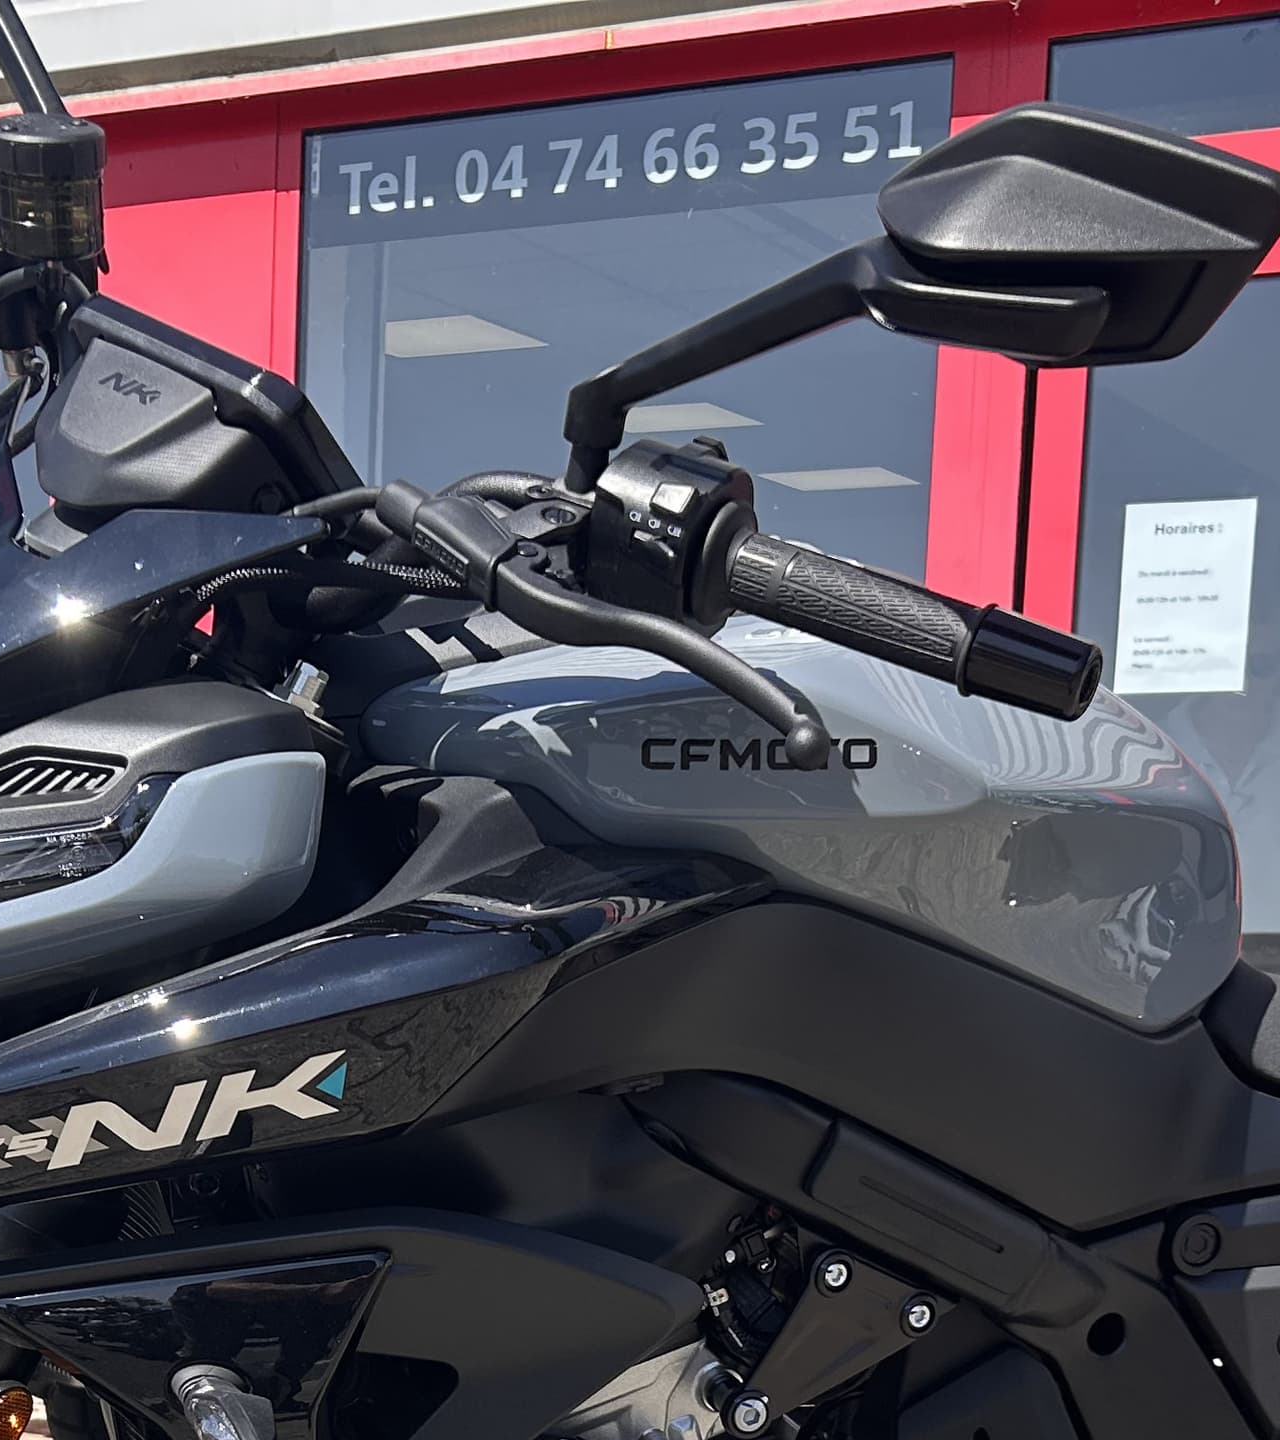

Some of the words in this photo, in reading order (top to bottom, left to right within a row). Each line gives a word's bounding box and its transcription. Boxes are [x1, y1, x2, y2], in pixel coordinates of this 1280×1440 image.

[339, 155, 435, 215] Tel.
[455, 145, 528, 203] 04
[548, 134, 623, 194] 74
[643, 123, 720, 184] 66
[740, 112, 820, 174] 35
[842, 101, 922, 164] 51
[1154, 522, 1215, 536] Horaires
